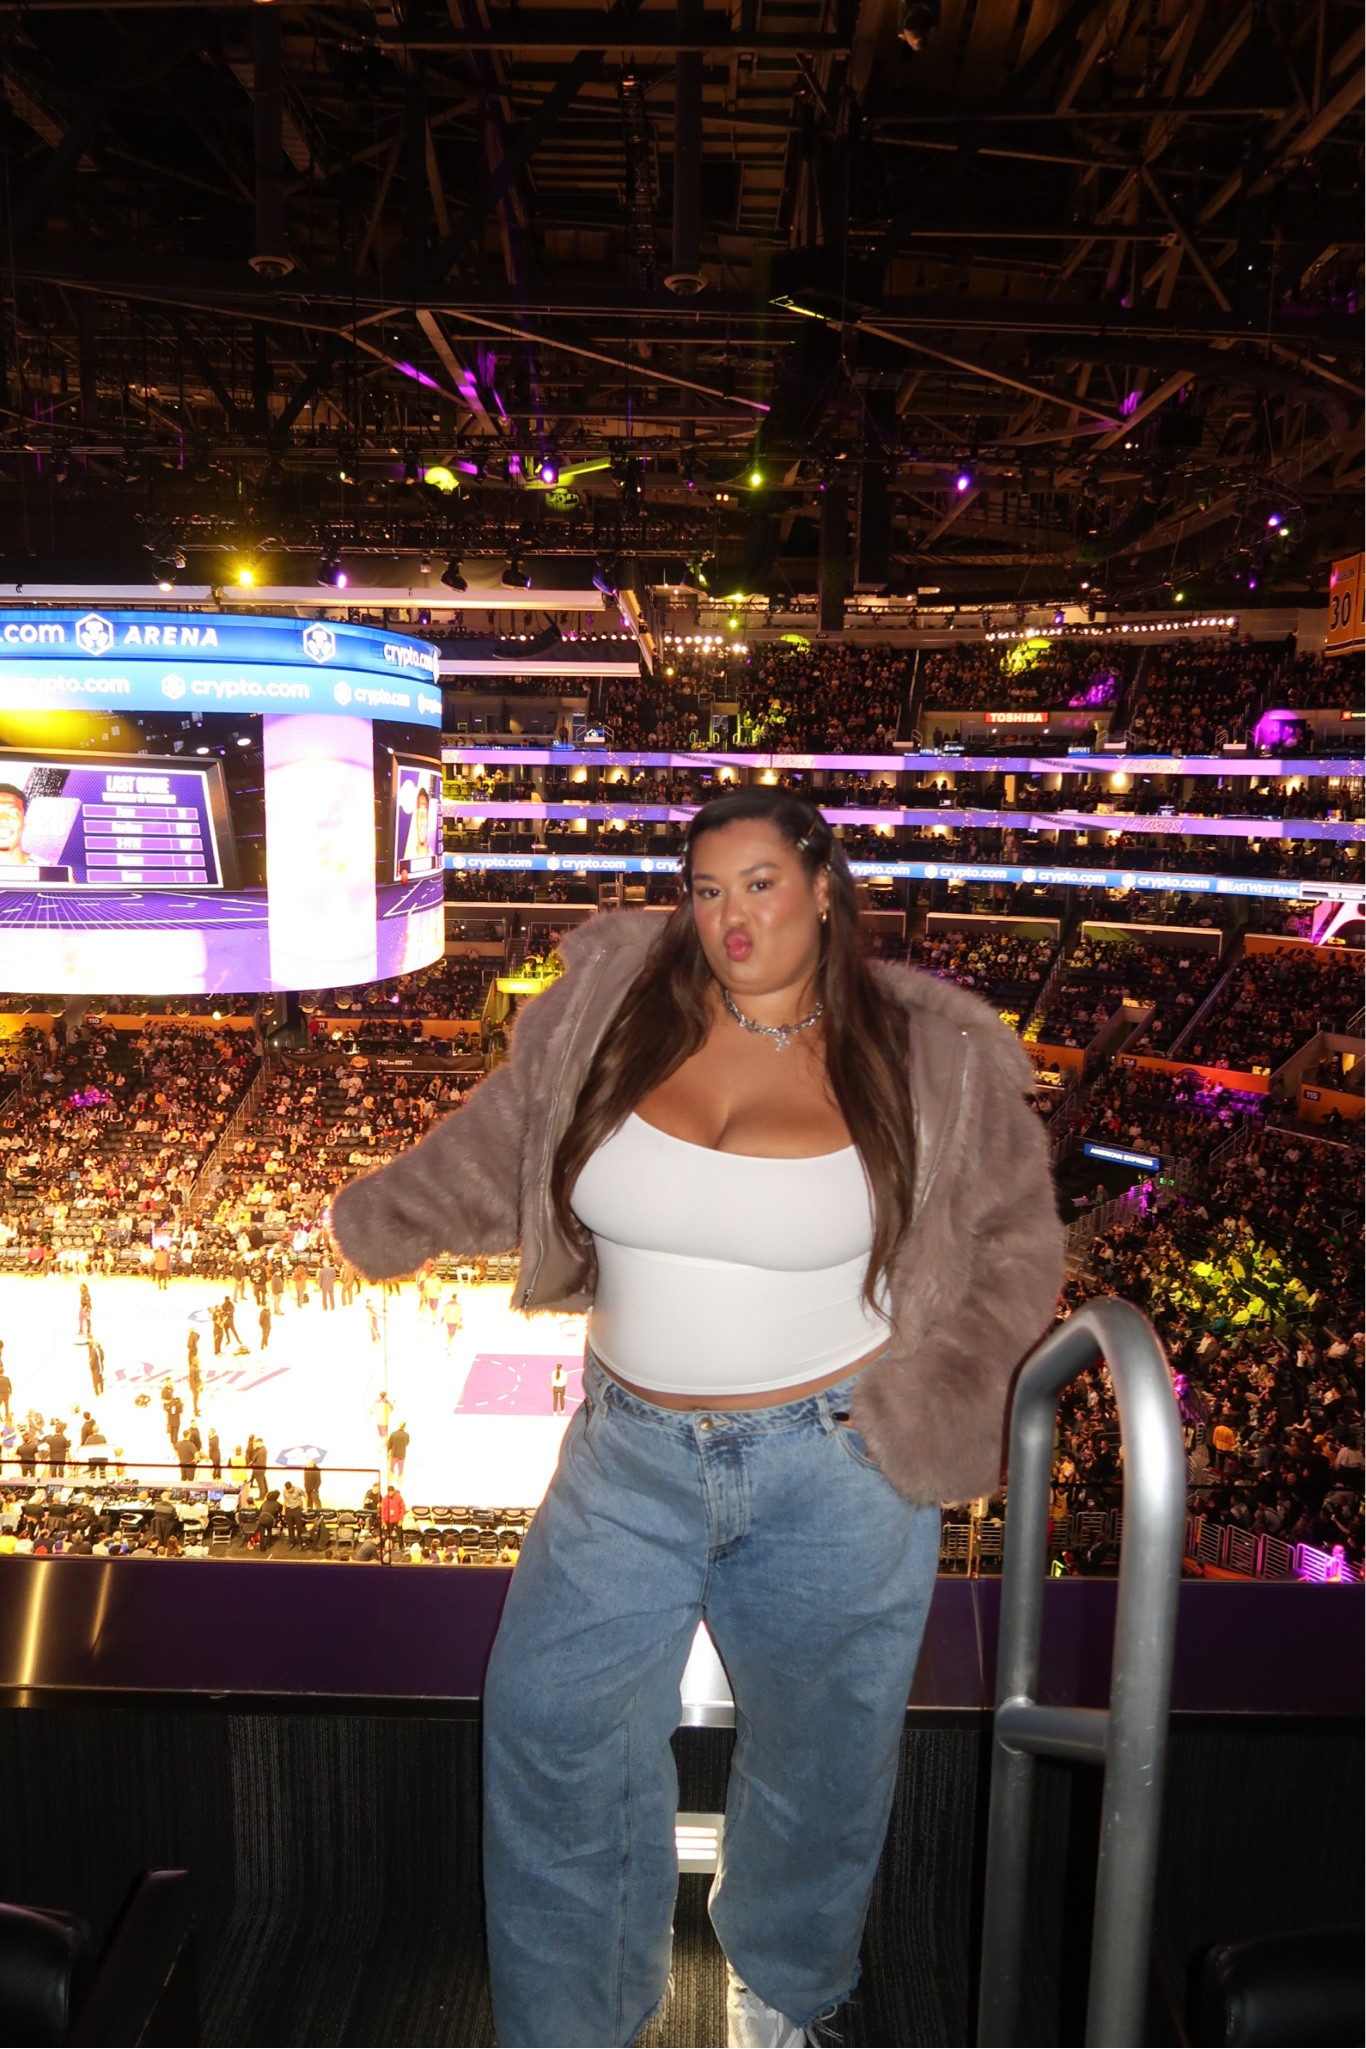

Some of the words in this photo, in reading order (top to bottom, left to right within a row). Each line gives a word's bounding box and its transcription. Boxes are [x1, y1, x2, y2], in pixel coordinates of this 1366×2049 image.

[1330, 591, 1351, 631] 30
[123, 625, 219, 647] ARENA
[190, 678, 310, 698] crypto.com
[989, 712, 1043, 723] TOSHIBA
[467, 857, 533, 869] crypto.com
[562, 858, 627, 870] crypto.com
[848, 863, 911, 876] rypto.com
[940, 867, 1007, 880] crypto.com
[1038, 870, 1106, 884] crypto.com
[1138, 876, 1210, 890] crypto.com
